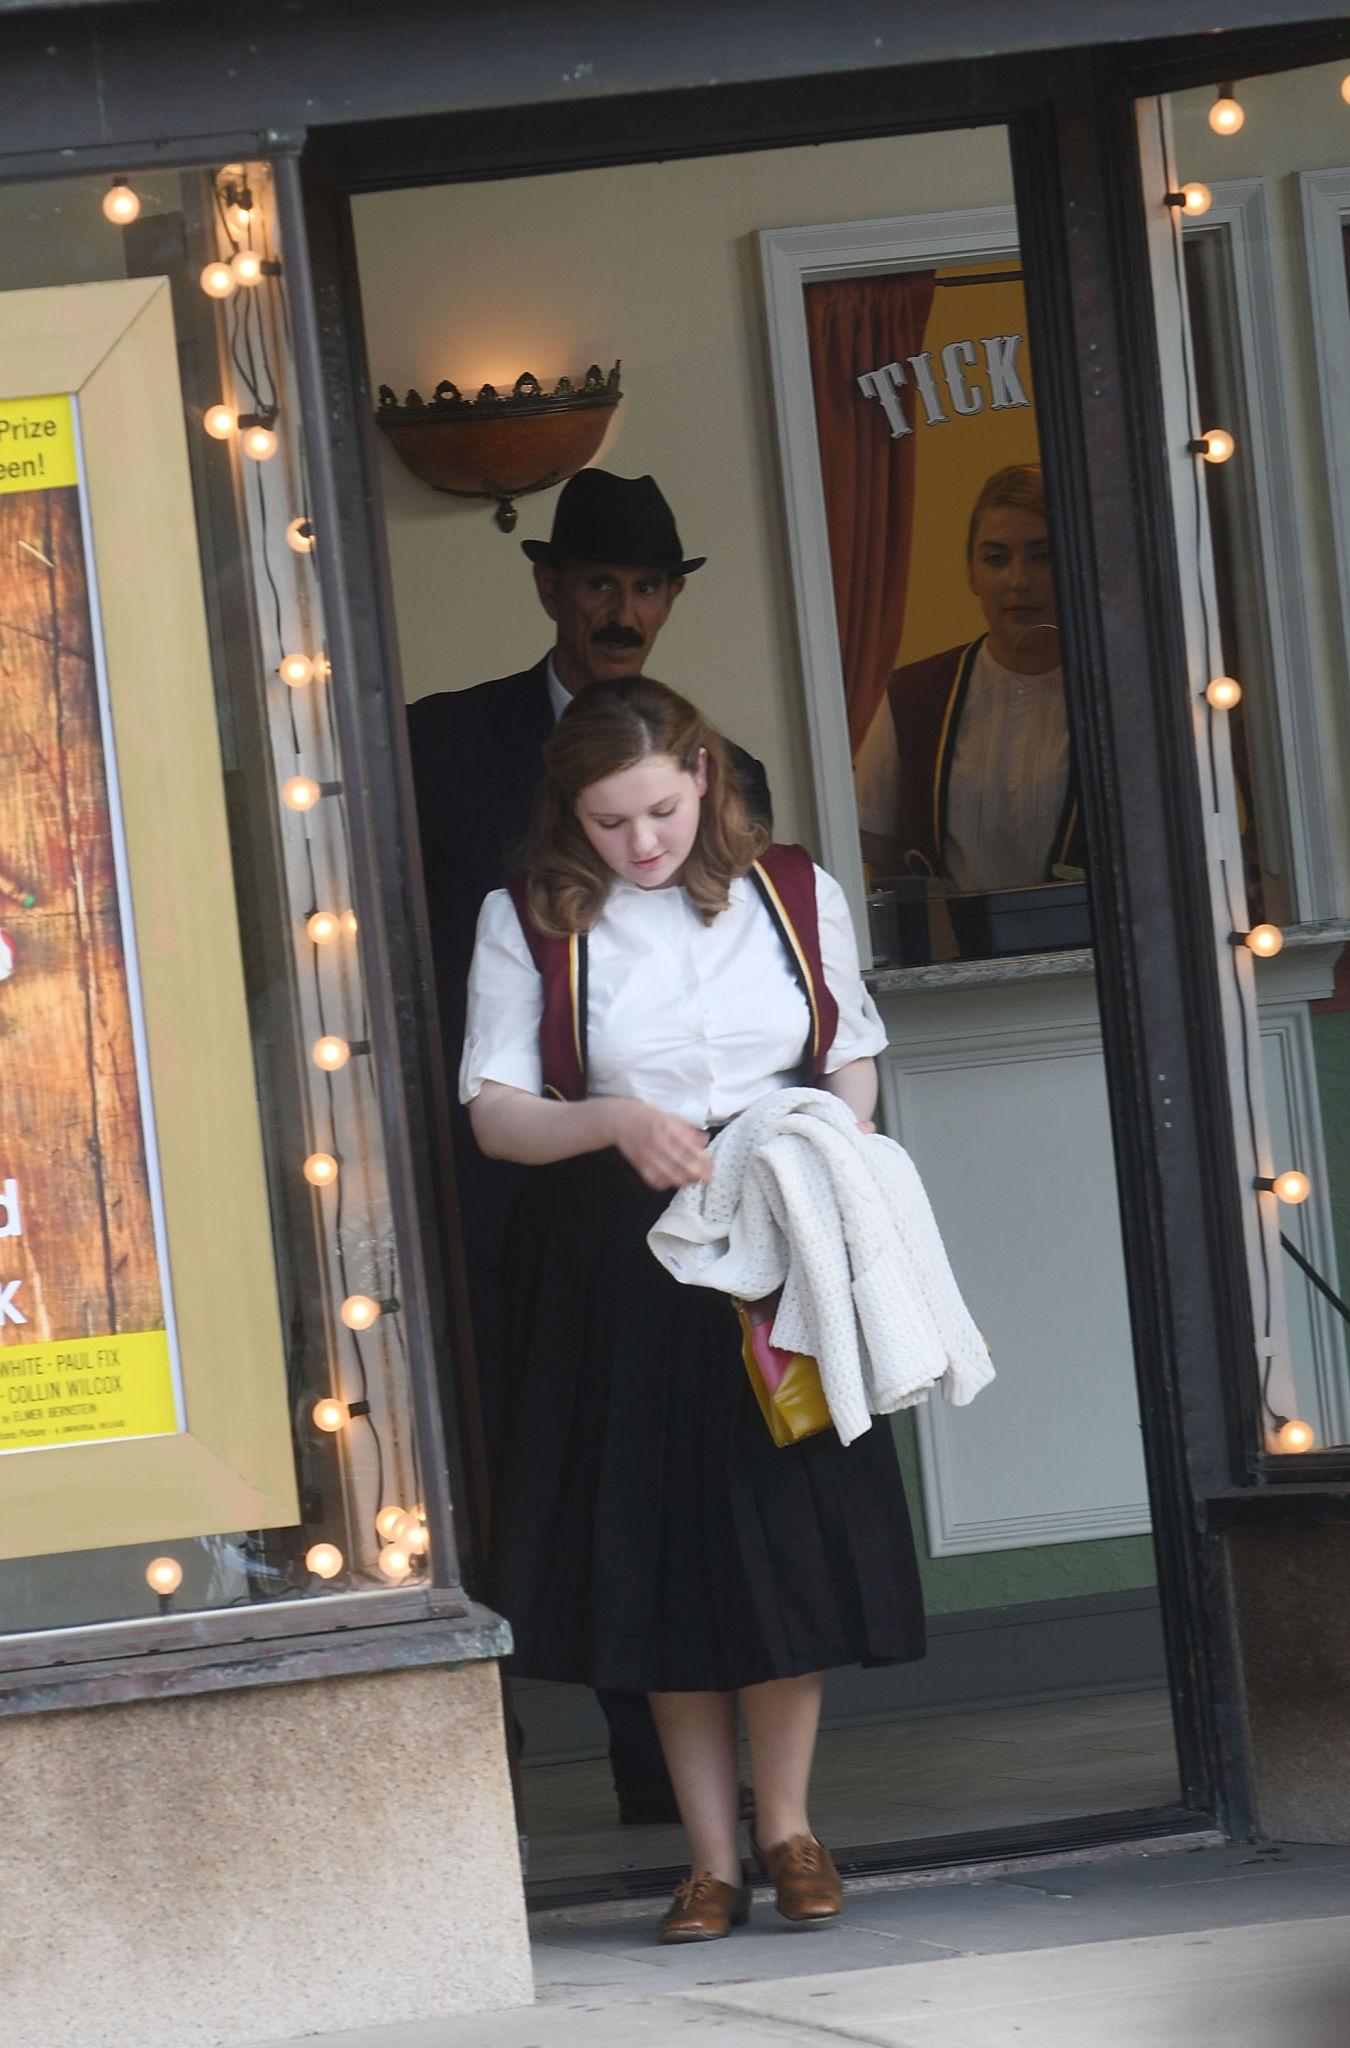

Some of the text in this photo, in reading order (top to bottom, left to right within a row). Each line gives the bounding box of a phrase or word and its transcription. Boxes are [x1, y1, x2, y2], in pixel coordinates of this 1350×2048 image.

[857, 335, 1031, 439] TICK
[0, 417, 57, 442] Prize
[0, 1357, 44, 1378] WHITE
[56, 1352, 93, 1372] PAUL
[97, 1348, 121, 1367] FIX
[8, 1382, 61, 1404] COLLIN
[65, 1375, 124, 1397] WILCOX
